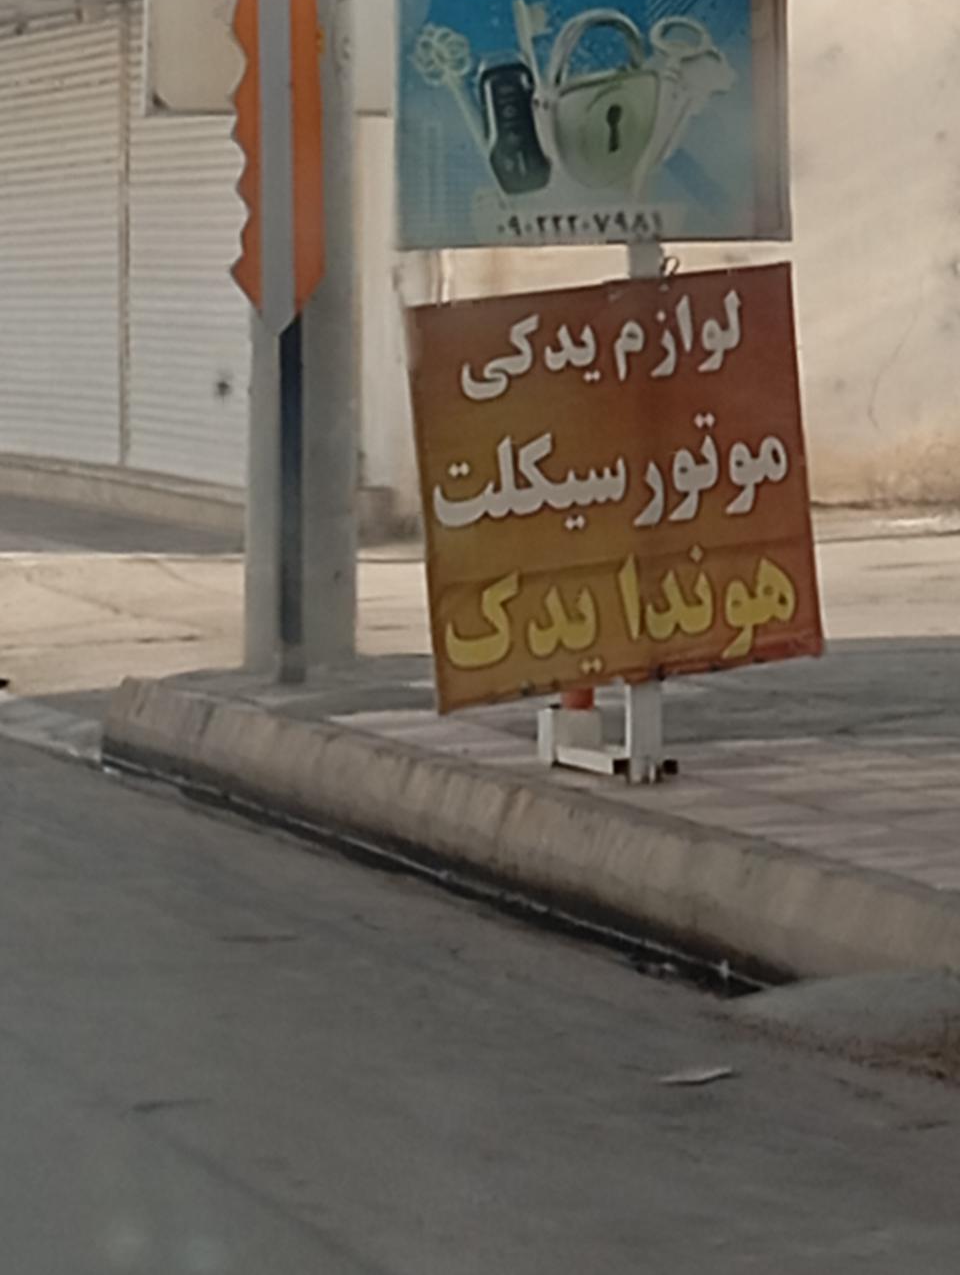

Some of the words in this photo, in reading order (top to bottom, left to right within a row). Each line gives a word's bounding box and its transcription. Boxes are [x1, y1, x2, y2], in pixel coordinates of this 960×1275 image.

[460, 313, 601, 400] یدکی
[614, 288, 743, 381] لوازم
[444, 569, 604, 674] یدک
[618, 545, 797, 660] هوندا
